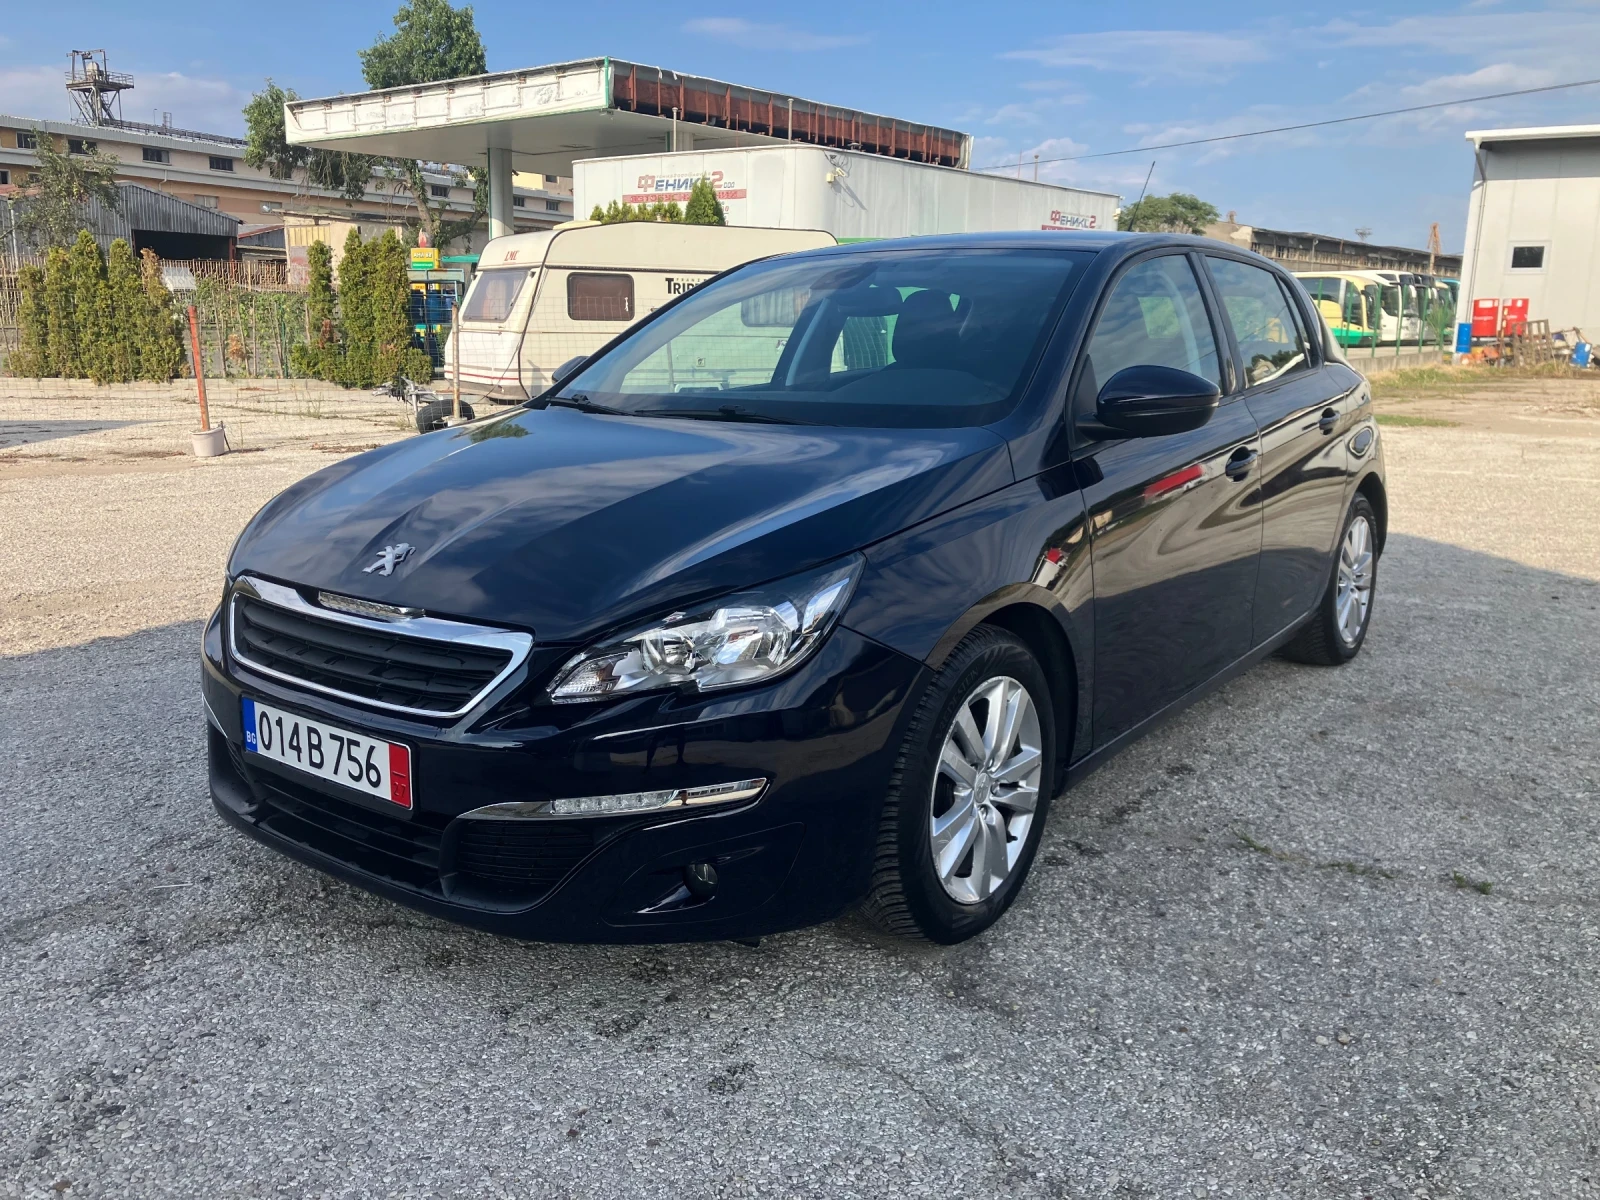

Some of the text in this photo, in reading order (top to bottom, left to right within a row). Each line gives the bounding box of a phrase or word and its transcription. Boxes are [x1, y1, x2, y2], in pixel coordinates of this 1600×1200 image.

[665, 277, 699, 295] TRIP
[246, 730, 257, 745] BG
[259, 710, 381, 789] 014B756
